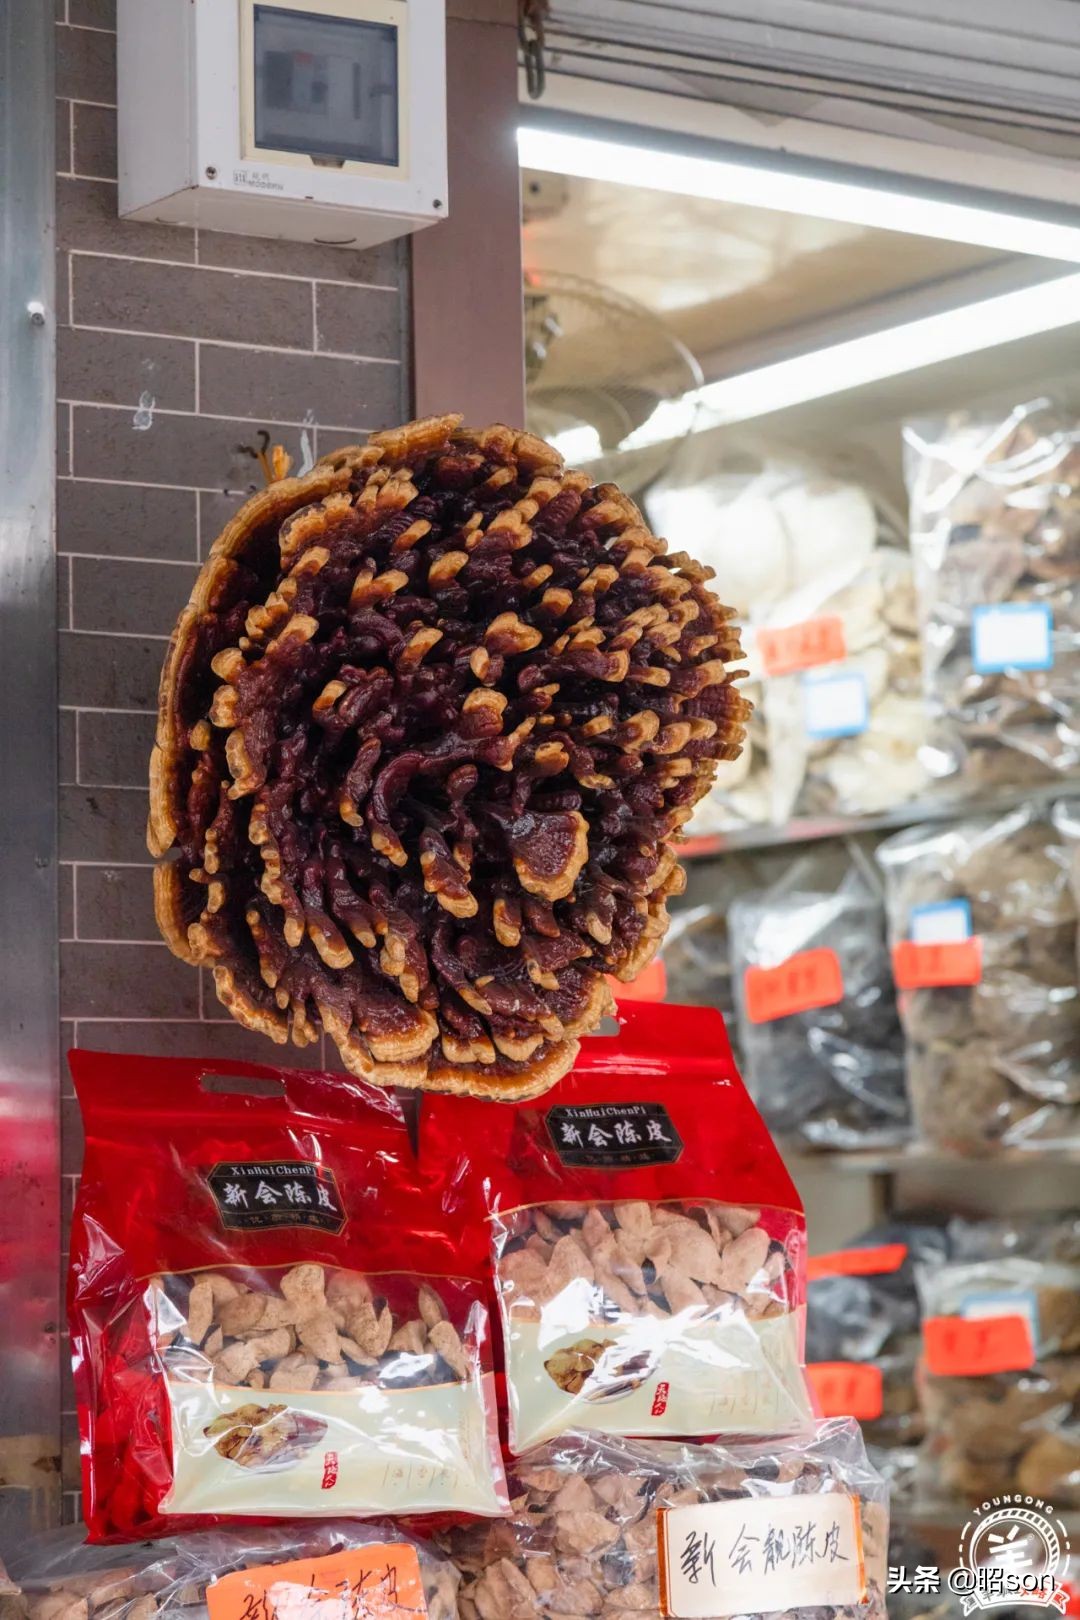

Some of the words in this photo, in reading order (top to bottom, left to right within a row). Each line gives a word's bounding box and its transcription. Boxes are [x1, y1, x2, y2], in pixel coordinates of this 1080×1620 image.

[565, 1105, 647, 1118] XinHuiChenPi
[560, 1119, 673, 1149] 新会陈皮
[222, 1180, 338, 1209] 新会陈皮
[680, 1520, 850, 1588] 新会靓陈皮
